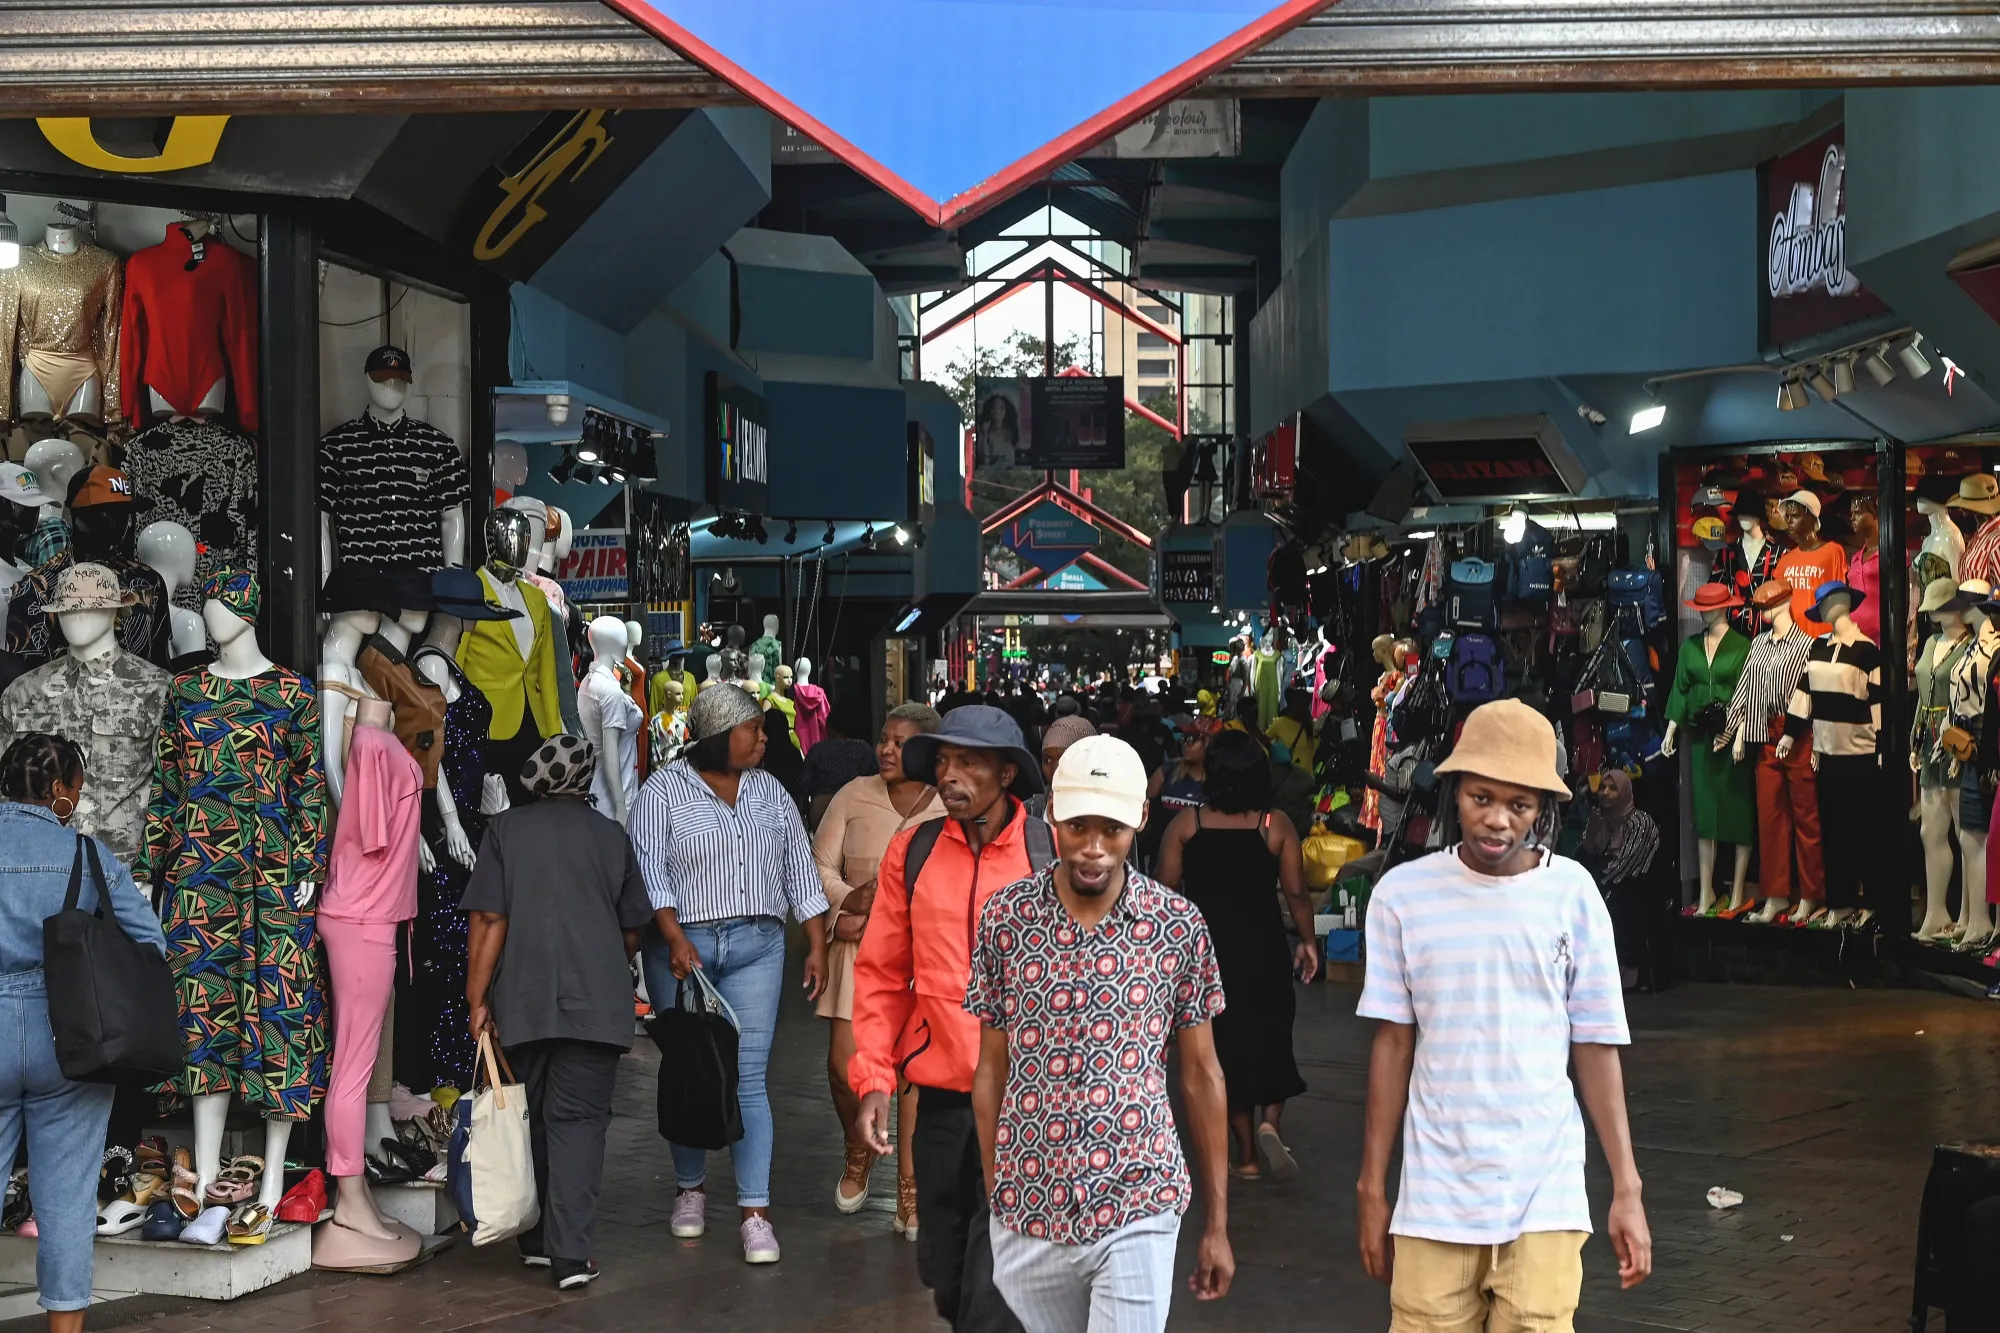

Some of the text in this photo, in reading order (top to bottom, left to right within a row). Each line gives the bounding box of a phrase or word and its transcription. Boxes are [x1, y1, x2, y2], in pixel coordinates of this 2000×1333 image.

[734, 406, 768, 485] 4 SEASONS
[558, 548, 628, 579] PAIR
[1177, 554, 1211, 564] FASHION
[1061, 572, 1084, 582] SMALL
[1783, 565, 1824, 579] GALLERY
[1060, 581, 1085, 590] STREET
